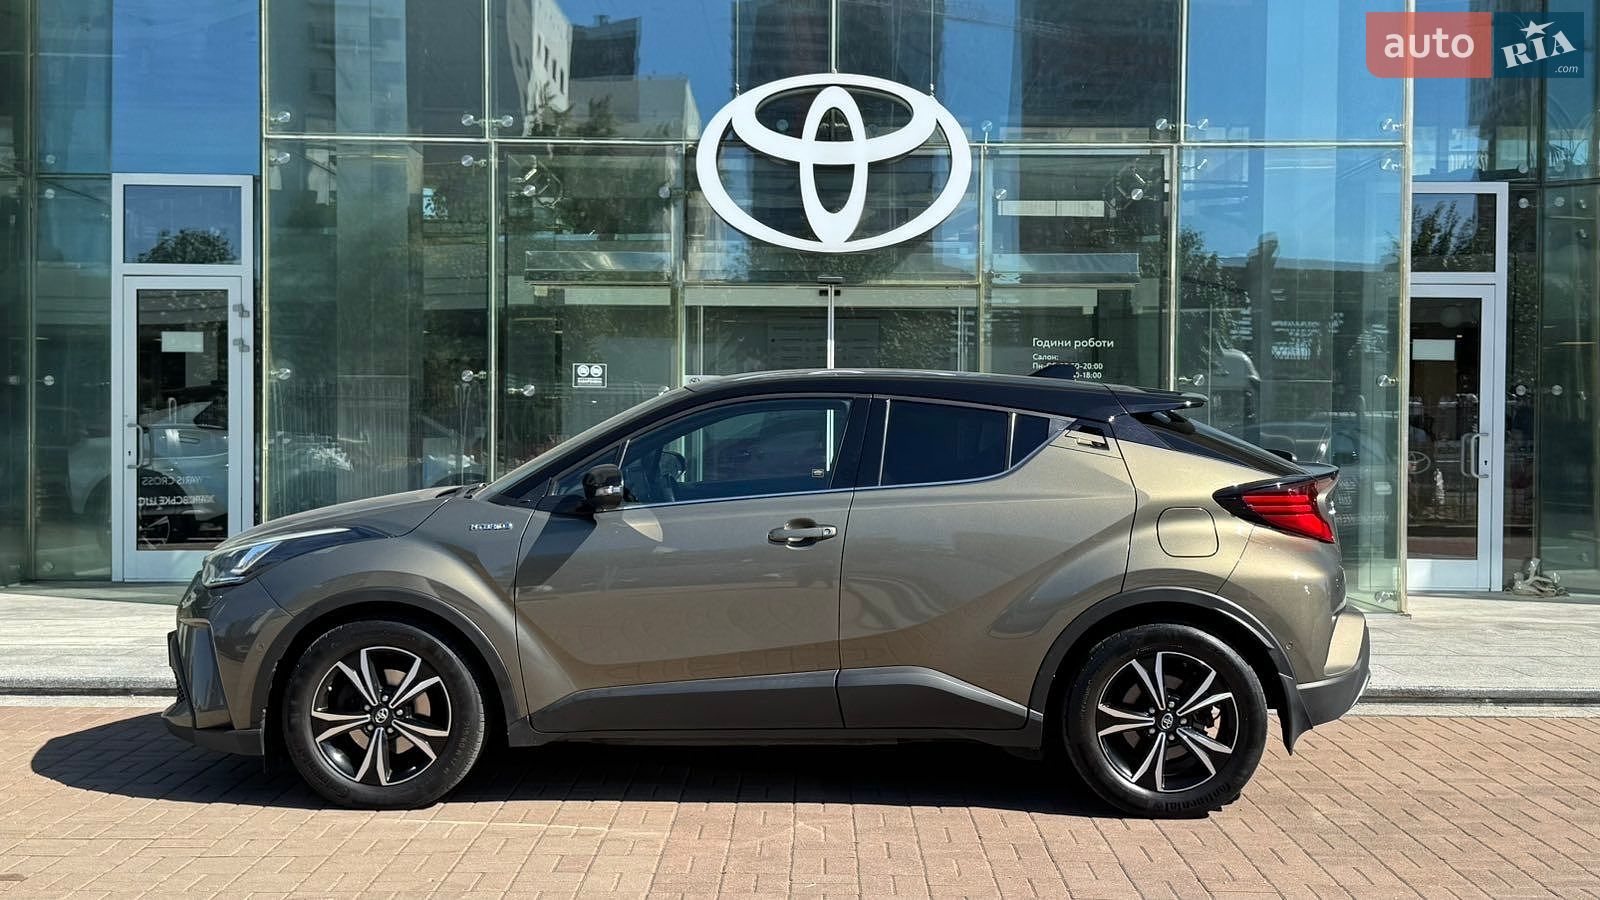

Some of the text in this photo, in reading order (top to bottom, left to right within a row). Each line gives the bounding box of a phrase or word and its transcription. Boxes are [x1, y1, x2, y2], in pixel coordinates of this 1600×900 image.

[1032, 337, 1114, 349] Години роботи
[1032, 353, 1059, 361] Салон:
